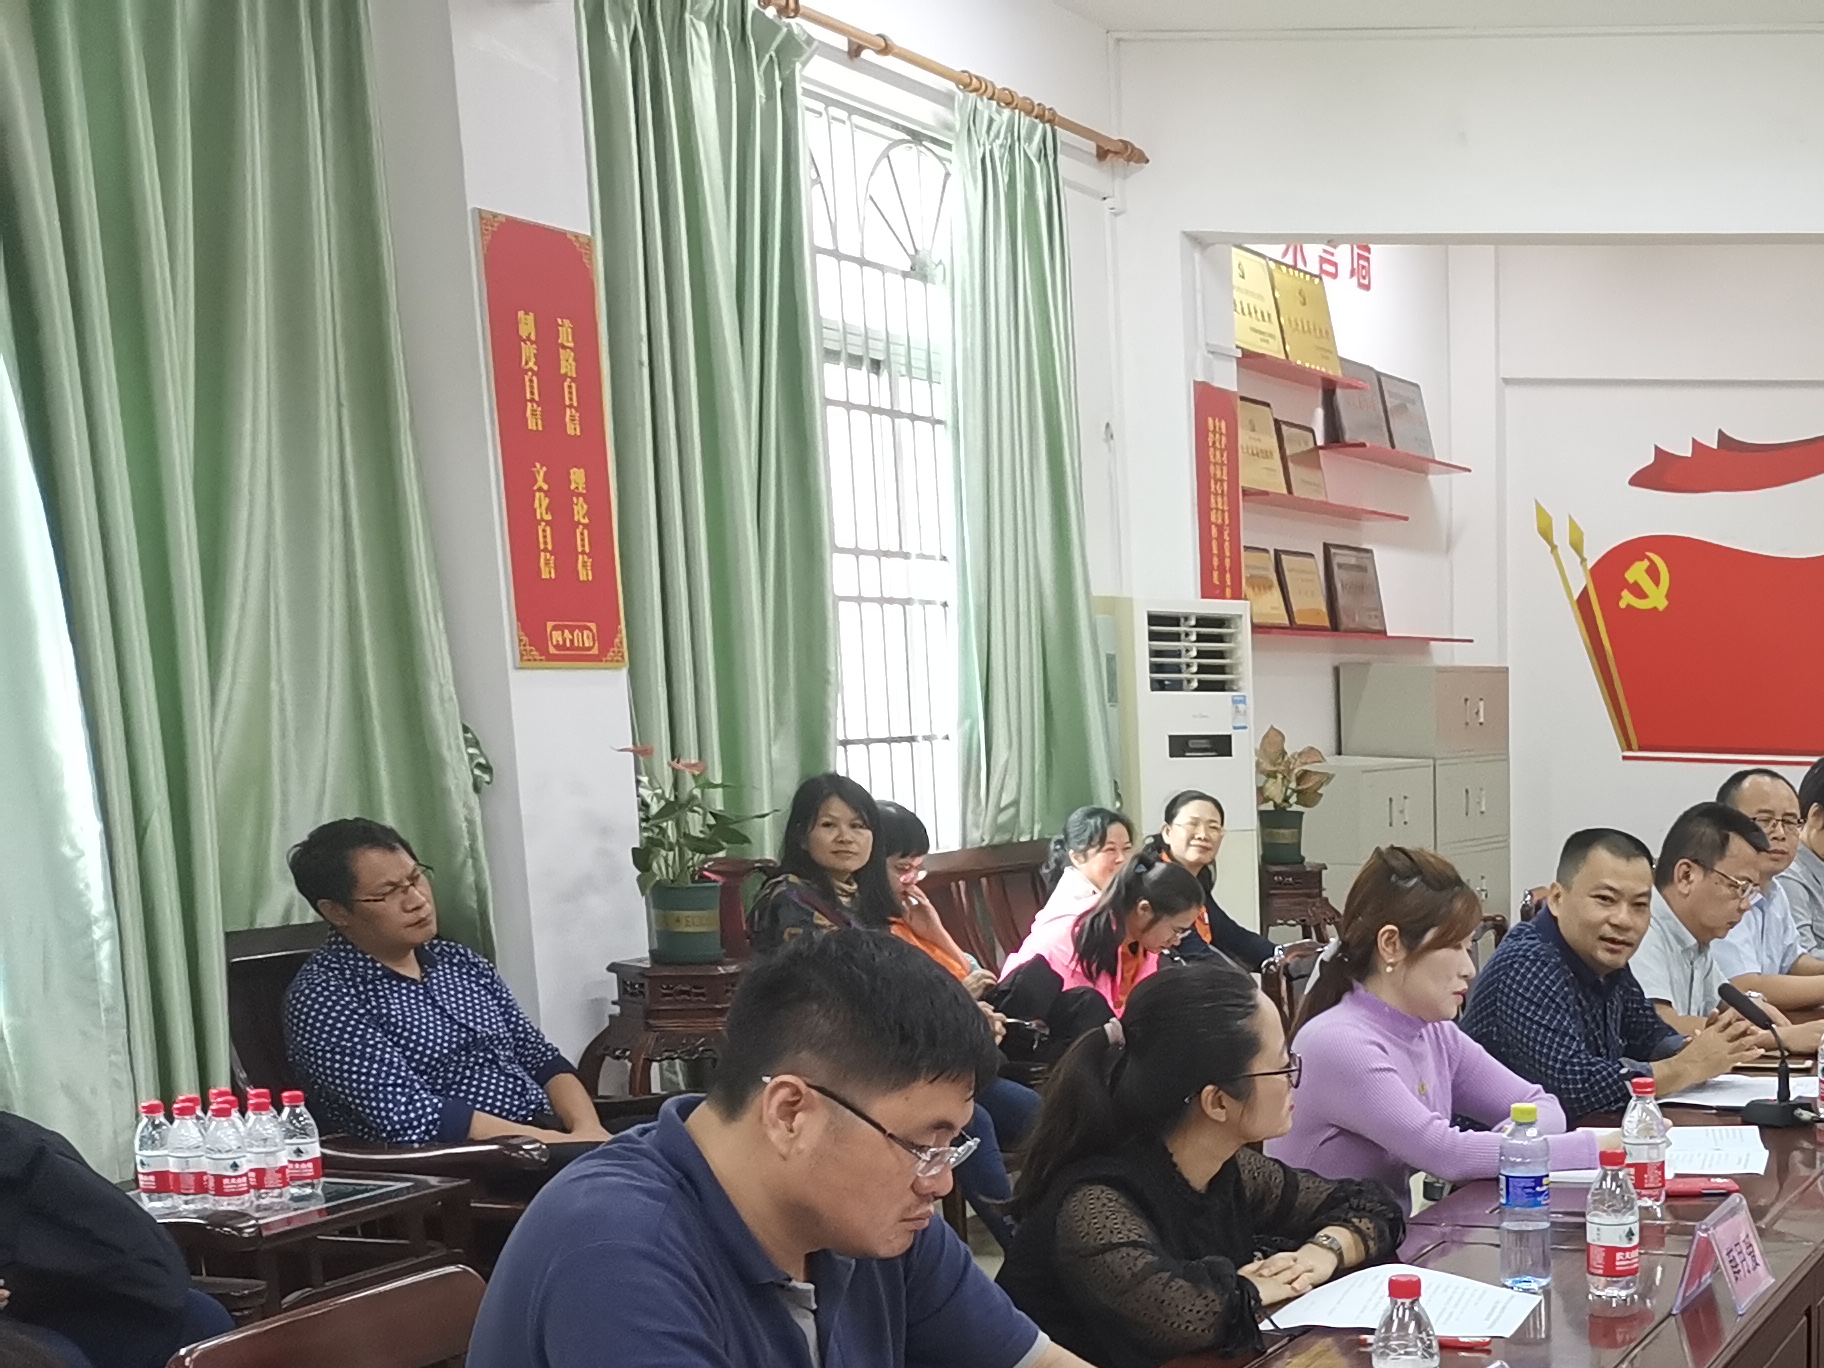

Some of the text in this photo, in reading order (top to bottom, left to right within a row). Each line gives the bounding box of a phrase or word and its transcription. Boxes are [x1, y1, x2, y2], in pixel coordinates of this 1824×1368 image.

[517, 310, 543, 431] 制度自信
[557, 318, 581, 436] 道路自信
[532, 462, 556, 580] 文化自信
[569, 467, 593, 582] 理论自信
[551, 628, 594, 648] 四个自信
